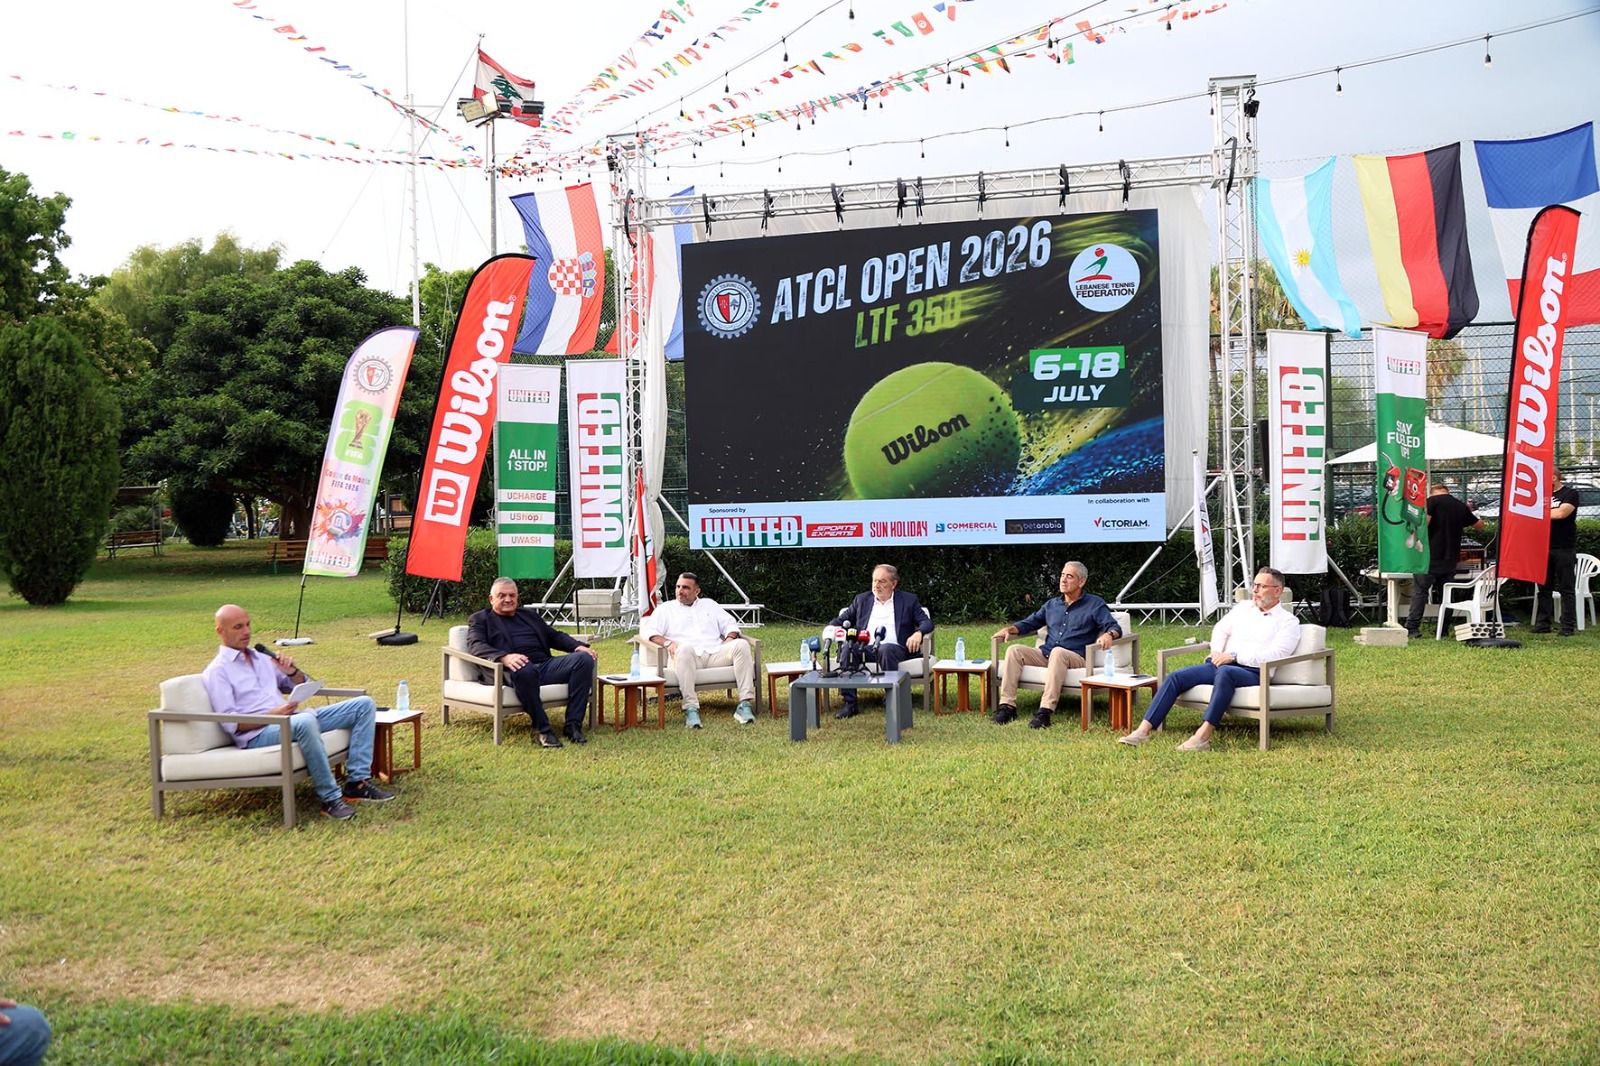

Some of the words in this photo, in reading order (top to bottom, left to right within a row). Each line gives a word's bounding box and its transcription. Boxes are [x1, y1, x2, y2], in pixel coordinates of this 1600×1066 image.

[770, 264, 851, 324] ATCL
[860, 241, 951, 304] OPEN
[959, 220, 1053, 284] 2026
[1075, 283, 1109, 291] LEBANESE
[1076, 288, 1135, 298] FEDERATION
[854, 304, 899, 348] LTF
[905, 290, 962, 337] 350
[1515, 255, 1567, 448] Wilson
[1033, 352, 1120, 381] 6-18
[435, 299, 514, 465] Wilson
[508, 389, 550, 403] UNITED
[1043, 385, 1106, 403] JULY
[881, 414, 970, 465] Wilson
[509, 449, 532, 460] ALL
[533, 450, 546, 460] IN
[507, 461, 512, 471] 1
[514, 461, 548, 471] STOP!
[577, 392, 626, 549] UNITED
[507, 492, 547, 501] UCHARGE
[701, 516, 803, 548] UNITED
[870, 521, 888, 538] SUN
[890, 520, 928, 537] HOLIDAY
[511, 536, 542, 544] UWASH
